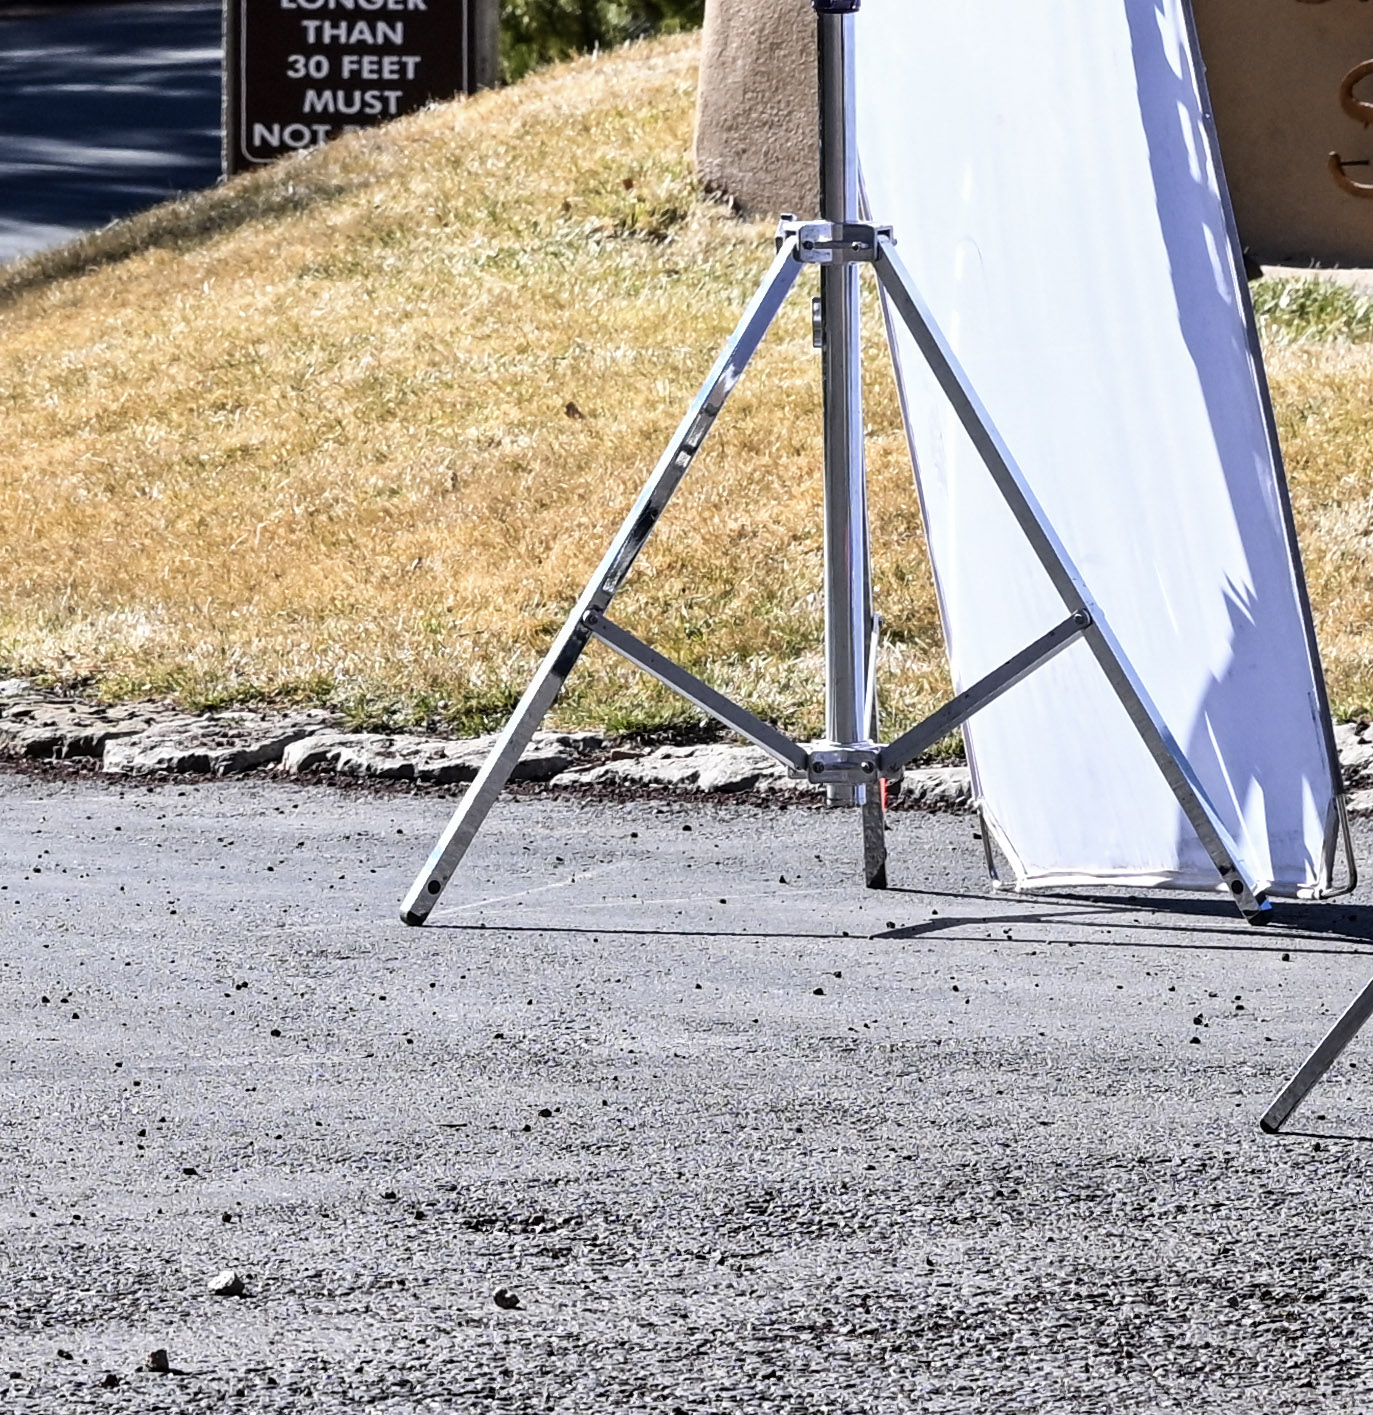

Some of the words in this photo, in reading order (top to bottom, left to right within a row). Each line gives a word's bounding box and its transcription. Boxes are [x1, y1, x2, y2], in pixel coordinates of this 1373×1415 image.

[301, 20, 404, 45] THAN
[286, 55, 330, 79] 30
[341, 55, 421, 80] FEET
[303, 89, 403, 114] MUST
[252, 123, 331, 148] NOT
